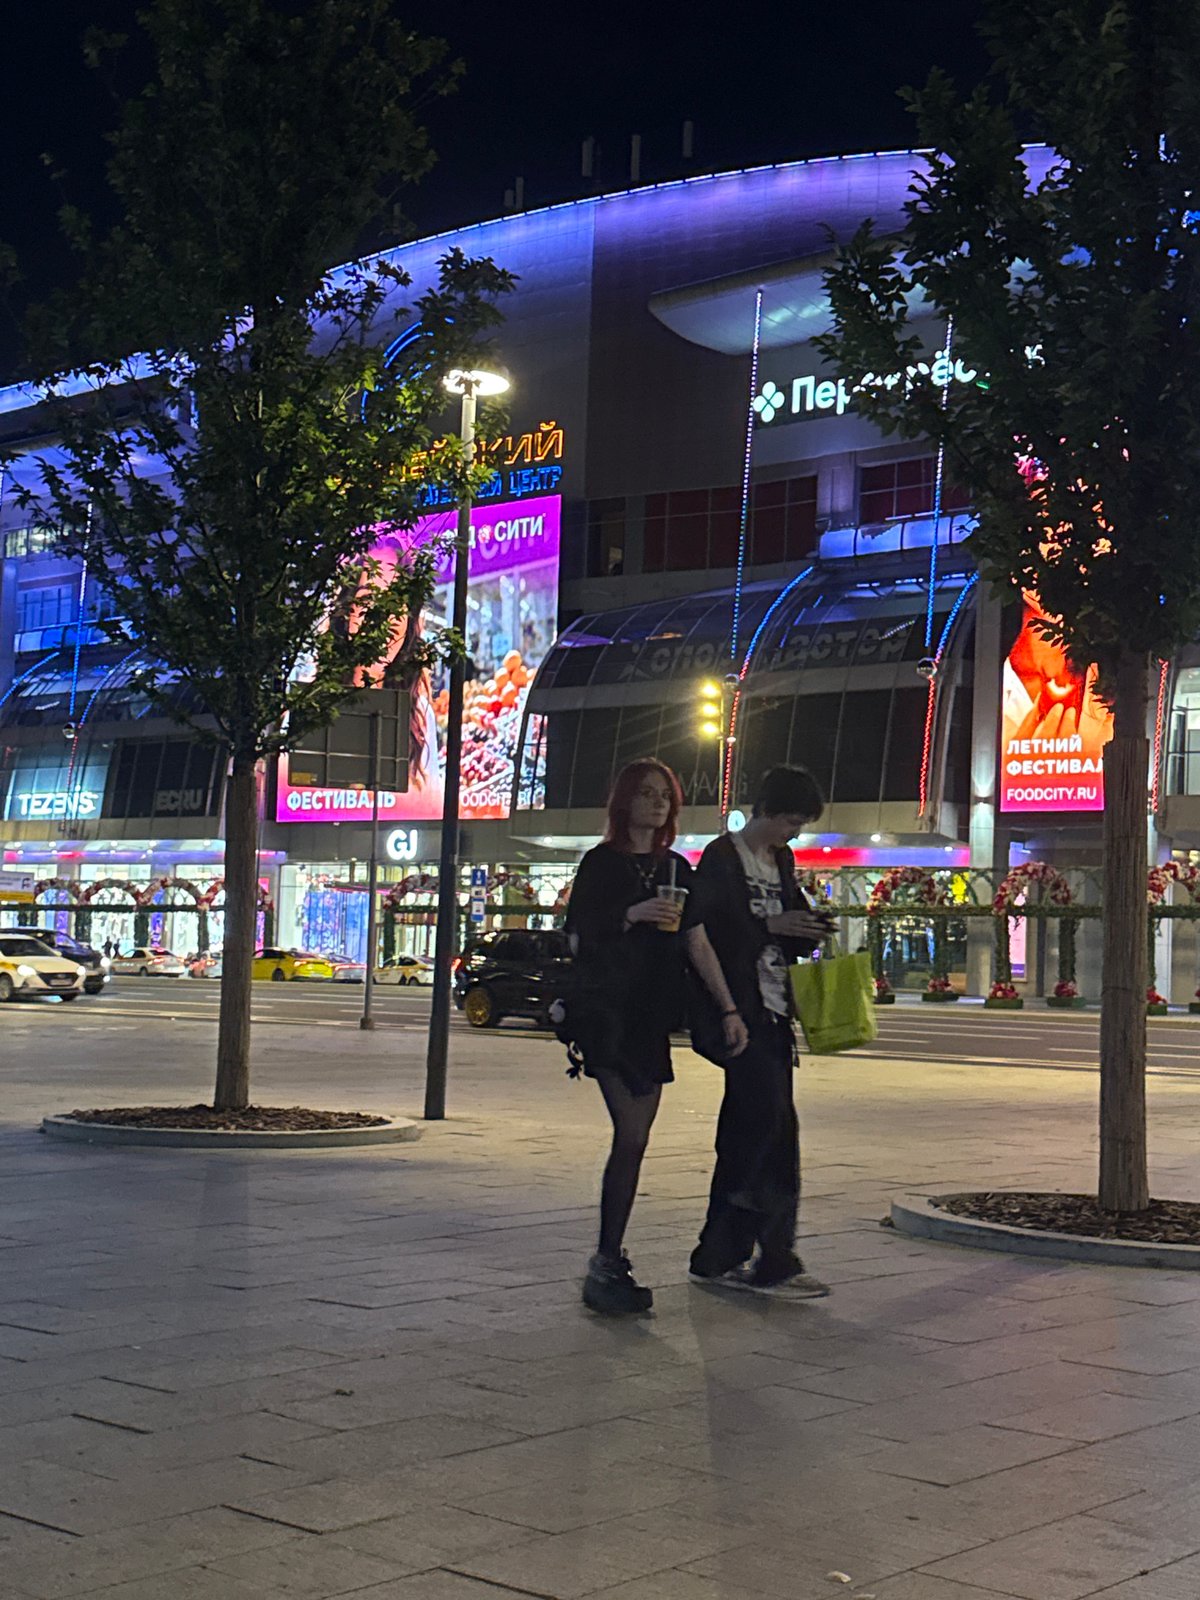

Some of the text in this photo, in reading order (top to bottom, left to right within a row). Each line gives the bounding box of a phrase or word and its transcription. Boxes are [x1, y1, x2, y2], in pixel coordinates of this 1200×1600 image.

[509, 465, 562, 497] ЦЕНТР
[494, 515, 543, 542] СИТИ
[1006, 734, 1082, 755] ЛЕТНИЙ
[1006, 758, 1104, 776] ФЕСТИВАЛ
[1006, 787, 1097, 801] FOODCITY.RU
[386, 829, 418, 861] GJ
